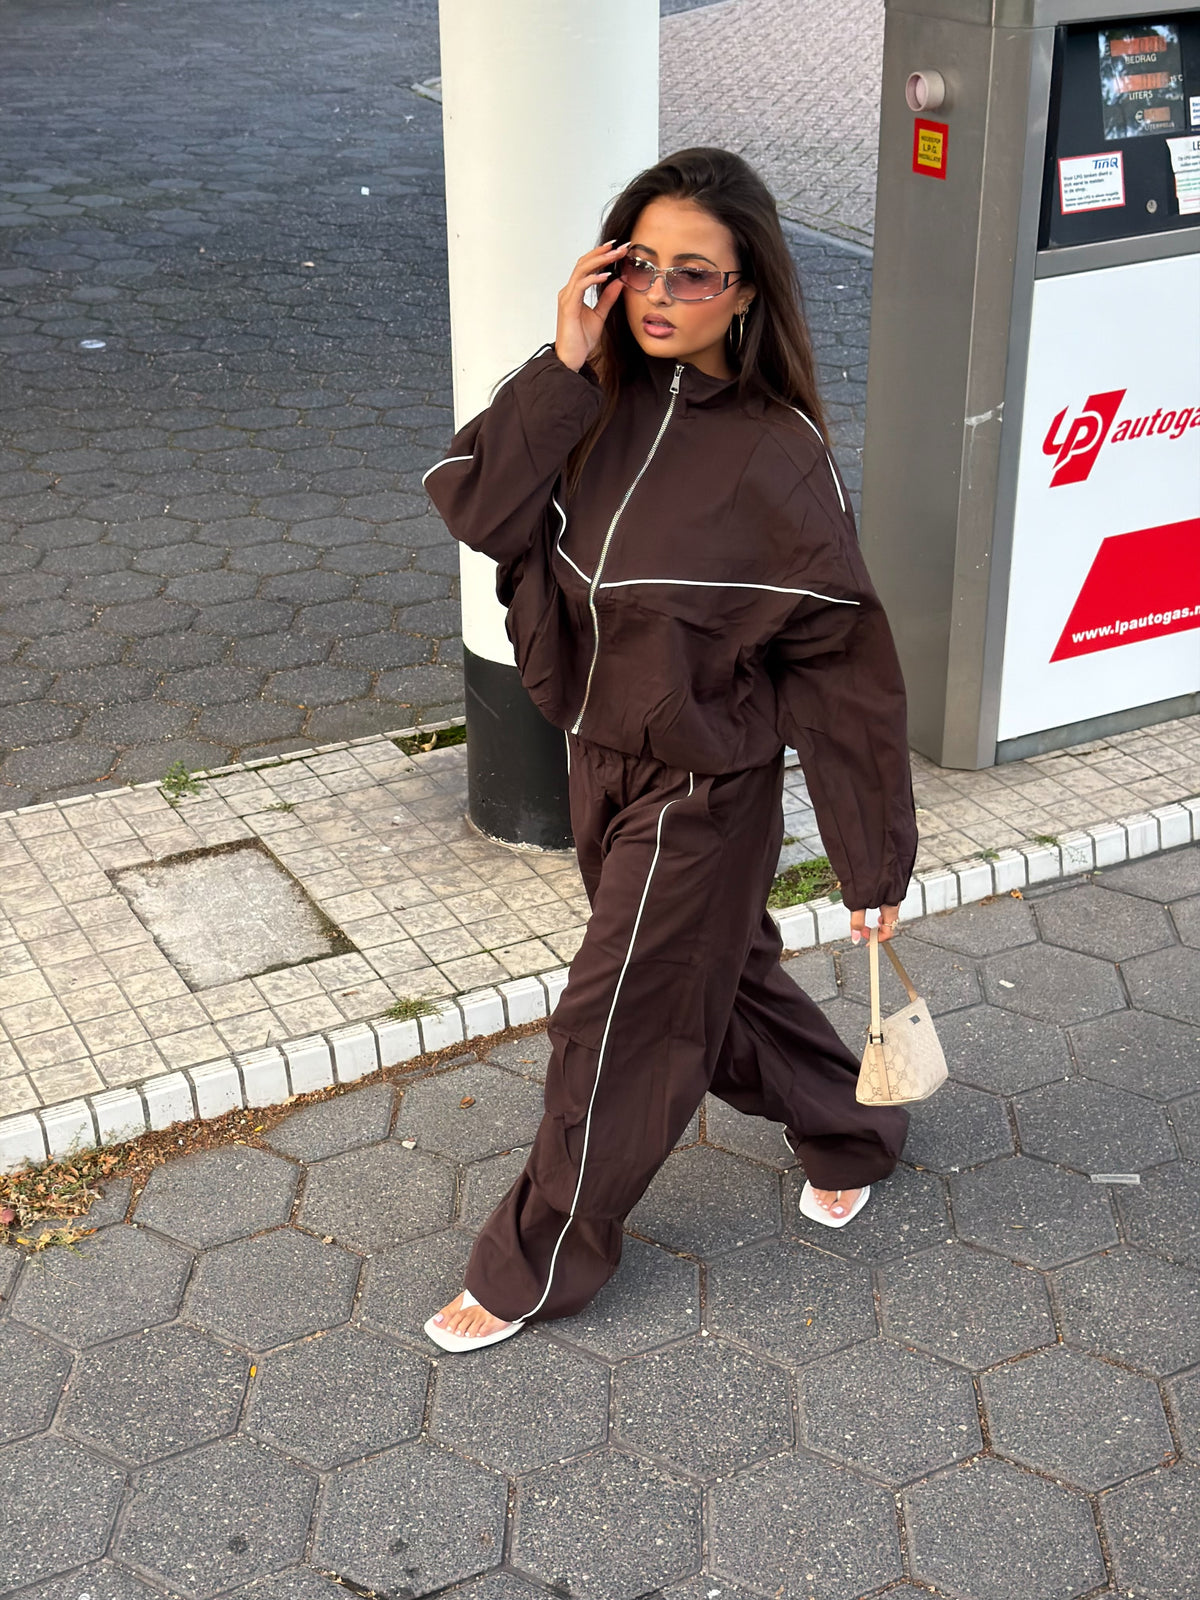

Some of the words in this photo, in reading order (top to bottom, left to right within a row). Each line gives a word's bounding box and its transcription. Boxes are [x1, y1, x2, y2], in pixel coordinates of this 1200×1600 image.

[1125, 53, 1157, 64] BEDRAG
[1129, 90, 1153, 100] LITERS
[1092, 157, 1118, 169] TinQ
